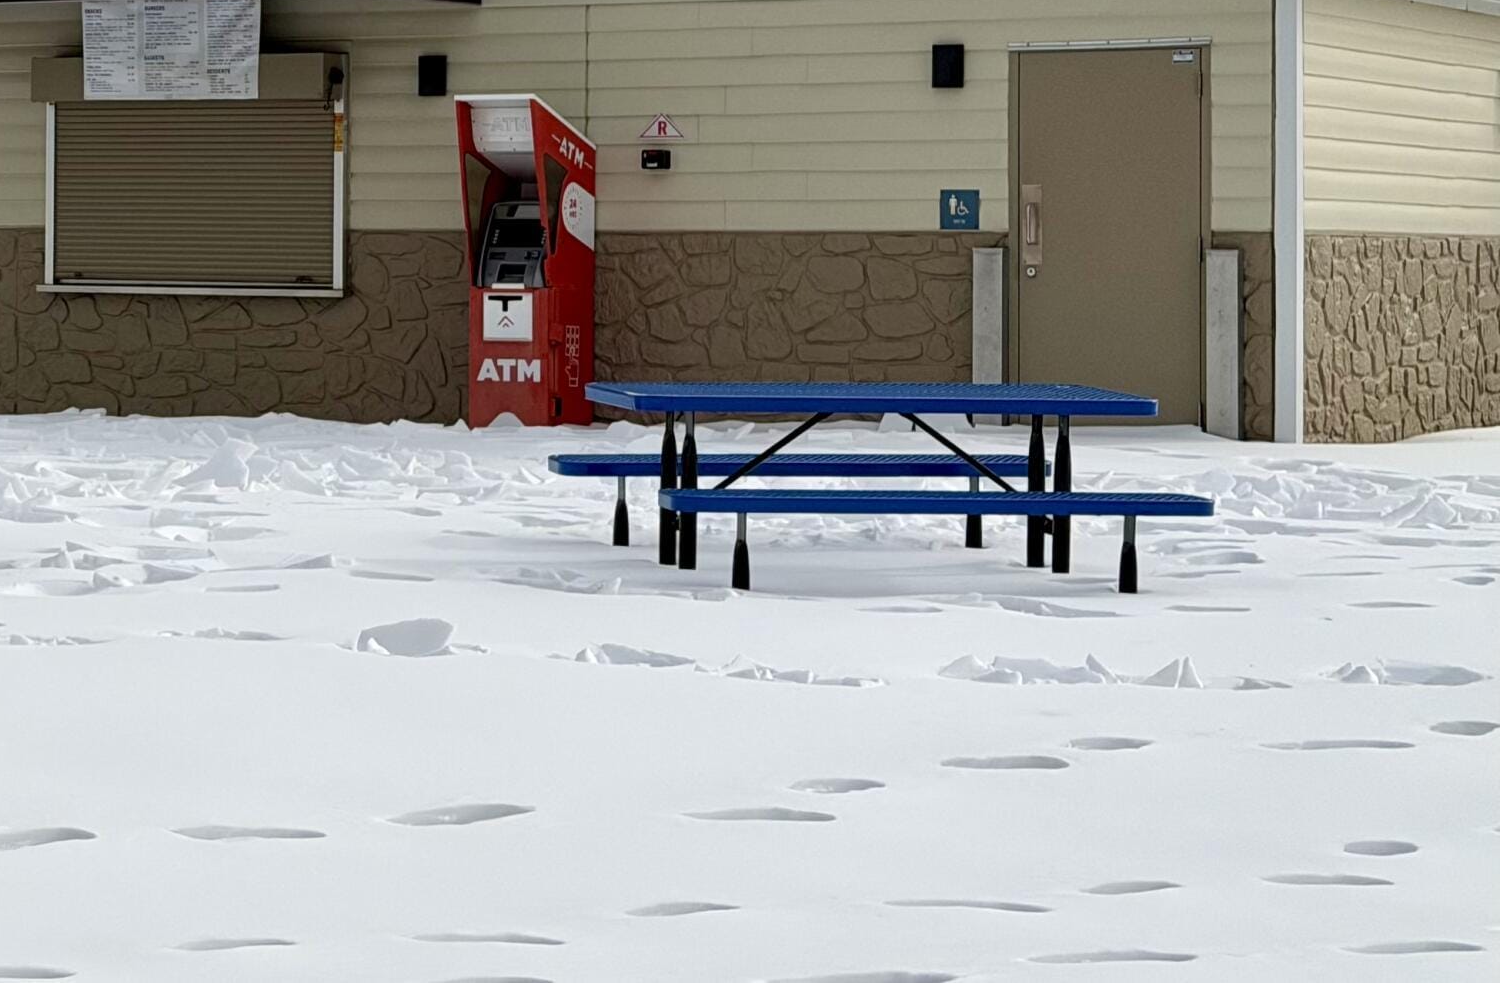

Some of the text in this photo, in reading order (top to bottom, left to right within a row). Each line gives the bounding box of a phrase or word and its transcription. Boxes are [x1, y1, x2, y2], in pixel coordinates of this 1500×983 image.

[657, 120, 668, 136] R
[559, 136, 585, 170] ATM
[476, 358, 541, 383] ATM
